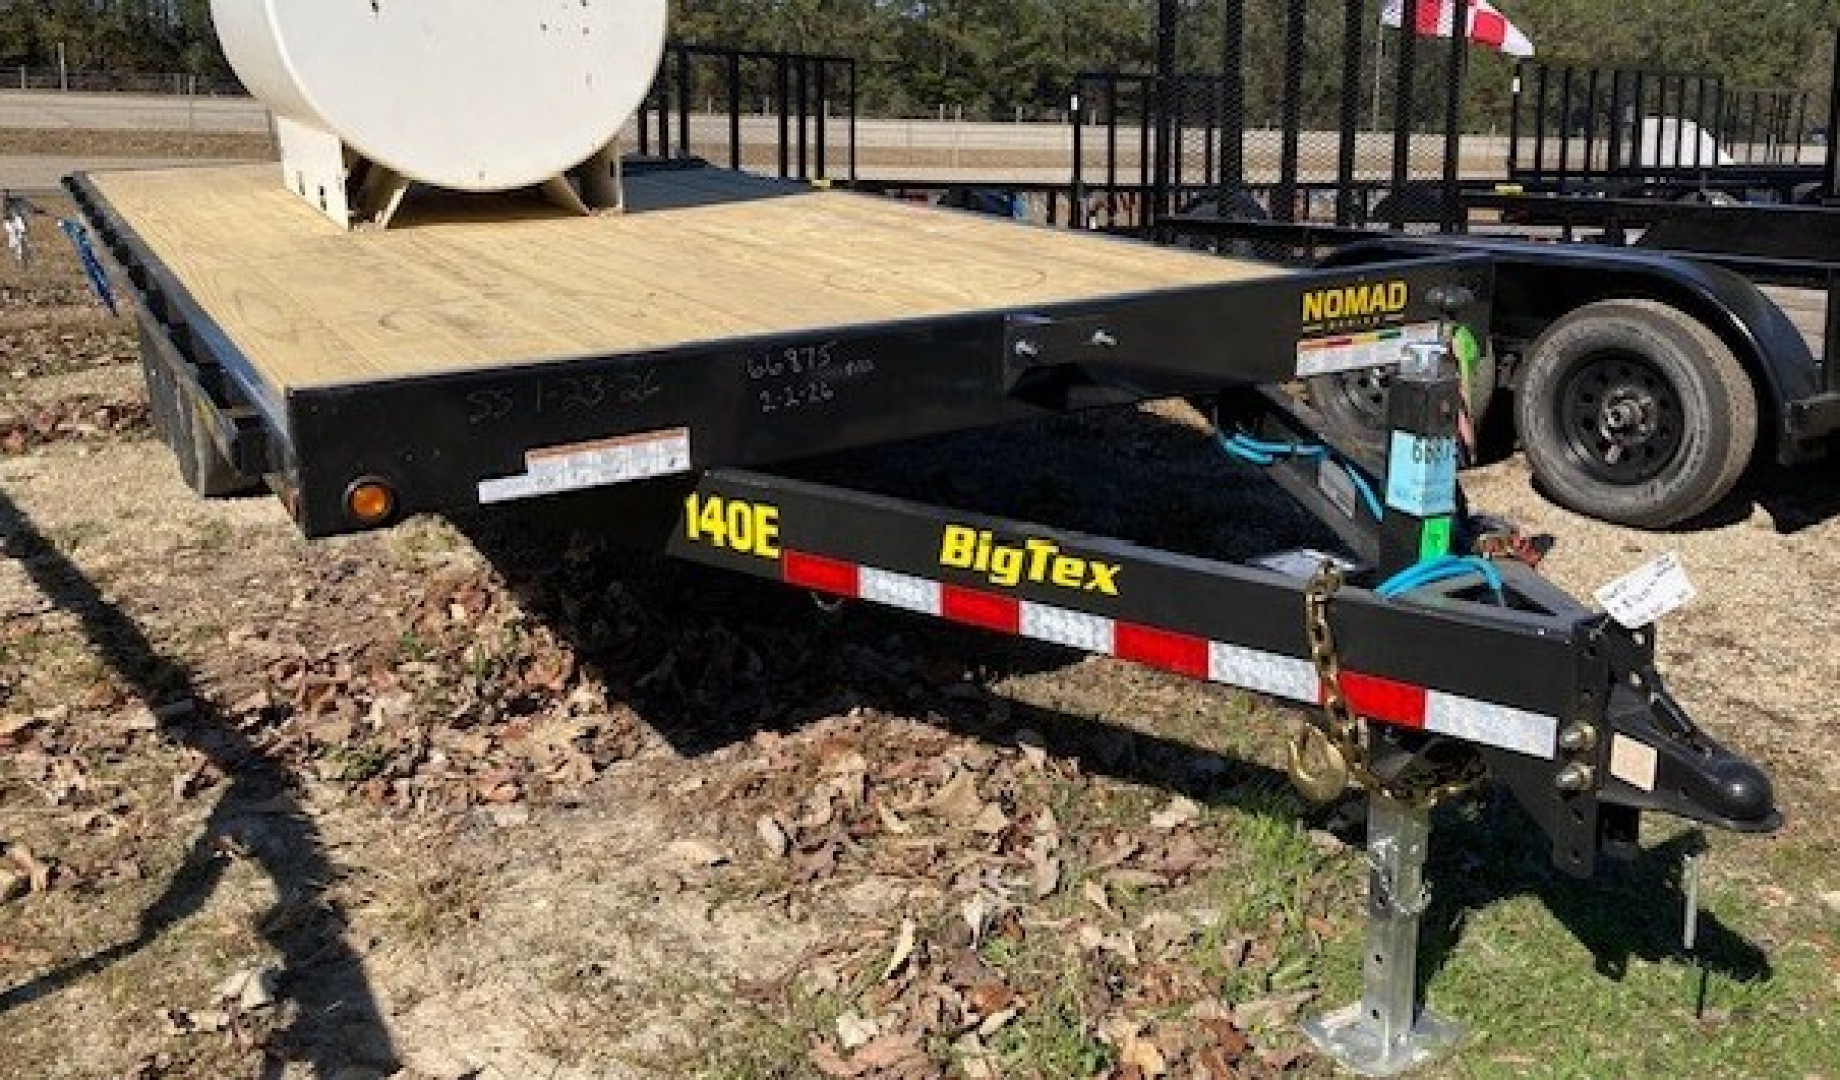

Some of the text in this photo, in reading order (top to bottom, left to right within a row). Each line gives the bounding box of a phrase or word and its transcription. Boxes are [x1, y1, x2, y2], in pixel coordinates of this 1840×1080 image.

[1302, 280, 1408, 321] NOMAD
[684, 491, 779, 558] 140E
[940, 524, 1123, 596] BigTex
